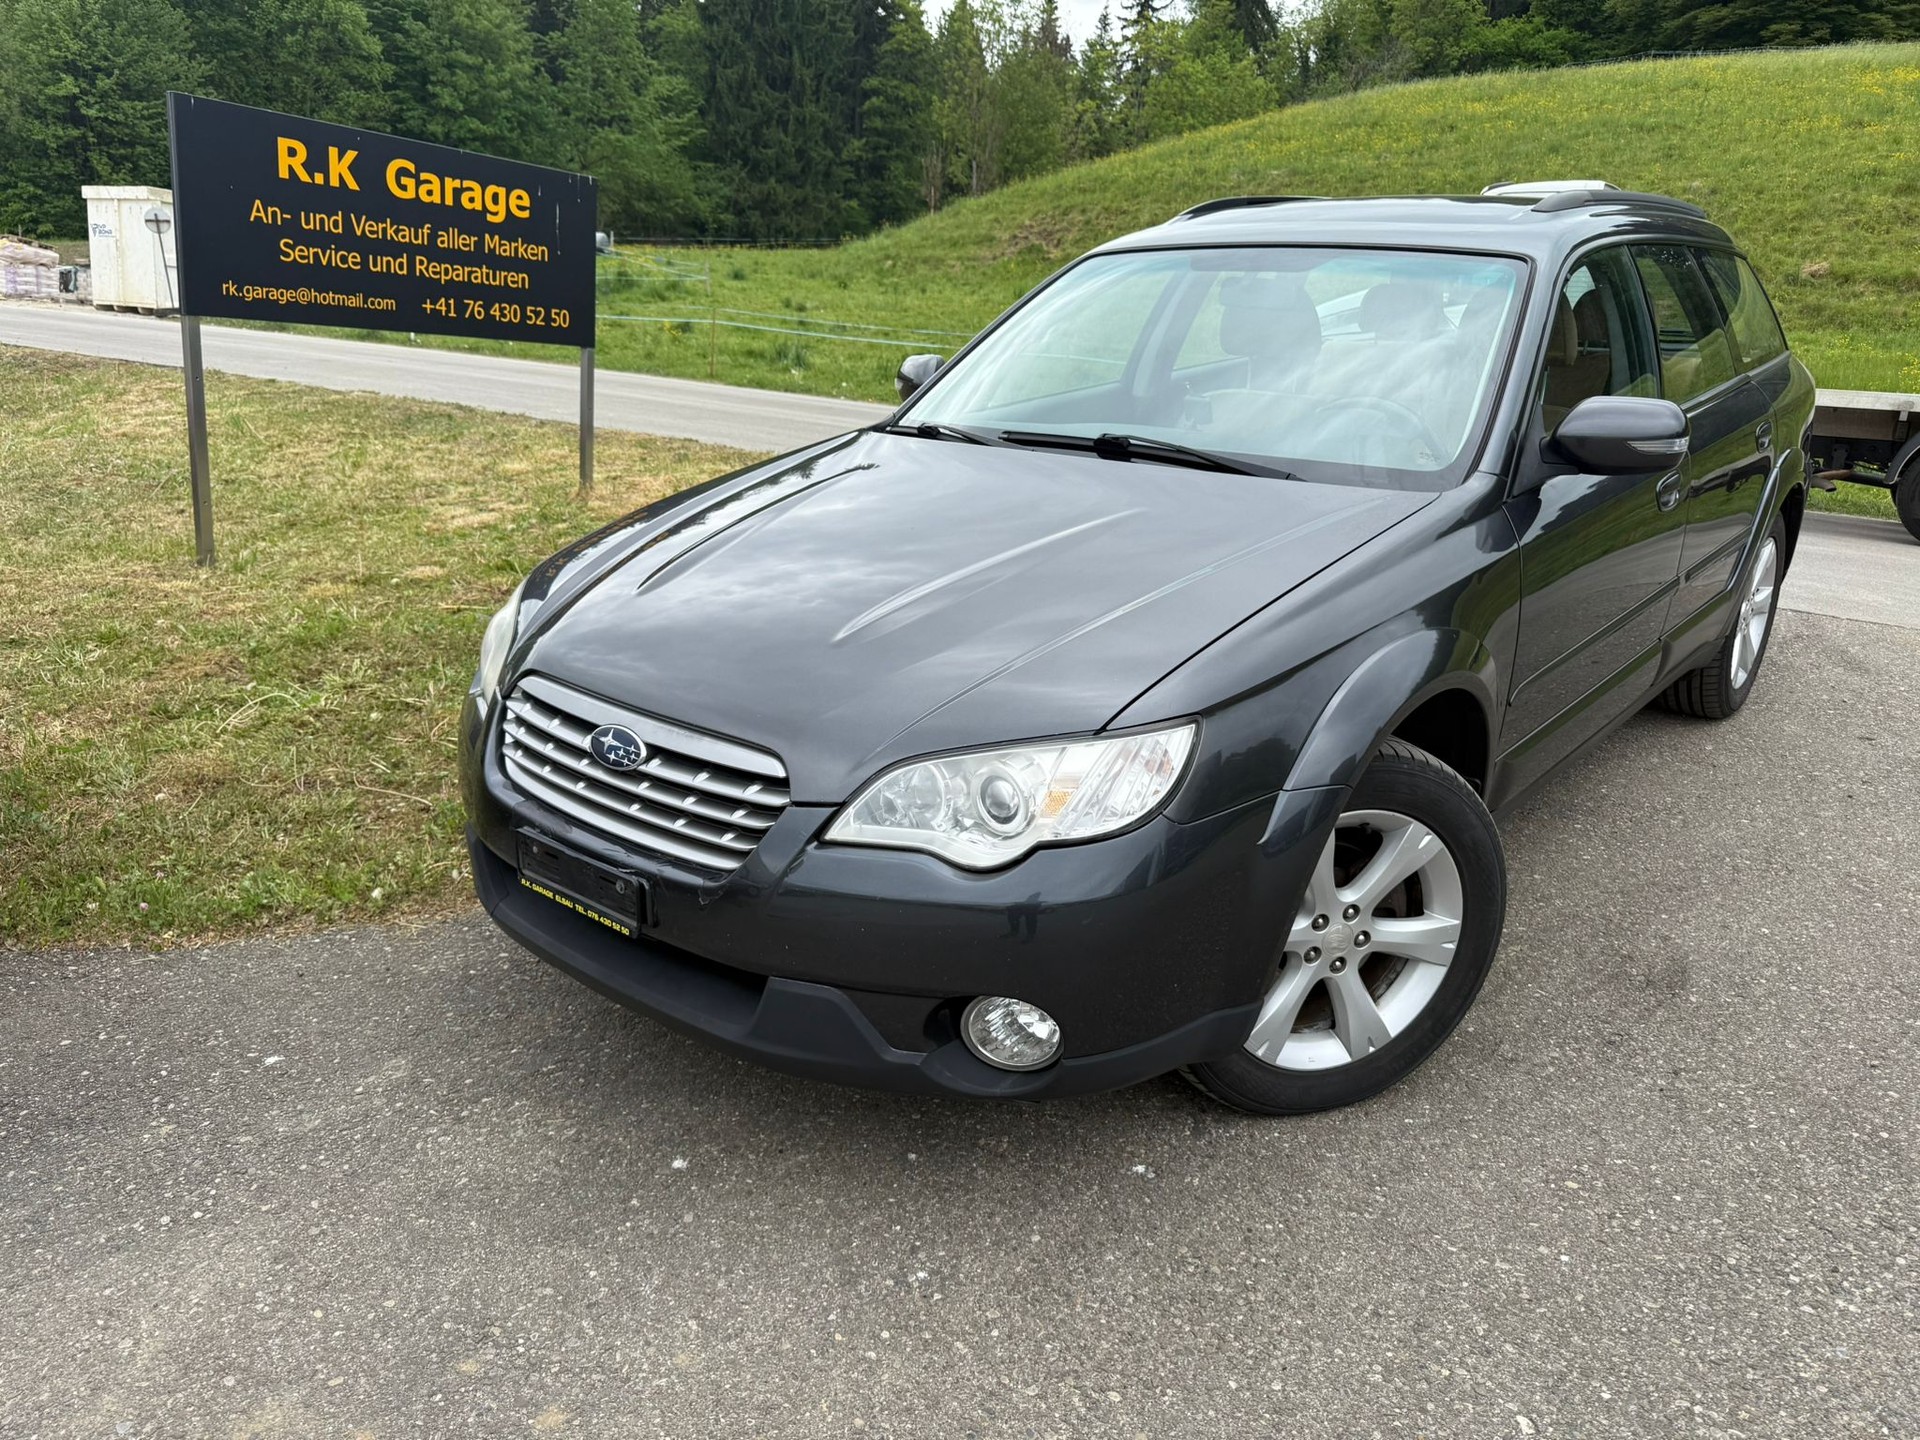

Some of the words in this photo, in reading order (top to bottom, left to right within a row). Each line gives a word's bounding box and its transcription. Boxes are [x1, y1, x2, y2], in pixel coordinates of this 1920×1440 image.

[277, 137, 360, 191] R.K
[386, 159, 530, 223] Garage
[250, 199, 292, 225] An-
[301, 212, 343, 234] und
[351, 214, 431, 246] Verkauf
[437, 229, 478, 252] aller
[485, 233, 549, 263] Marken
[279, 239, 361, 271] Service
[369, 254, 408, 276] und
[415, 256, 529, 290] Reparaturen
[222, 280, 396, 311] rk.garage@hotmail.com
[422, 297, 457, 317] +41
[464, 299, 485, 320] 76
[490, 303, 521, 324] 430
[527, 305, 546, 326] 52
[551, 308, 570, 329] 50
[532, 883, 553, 899] GARAGE
